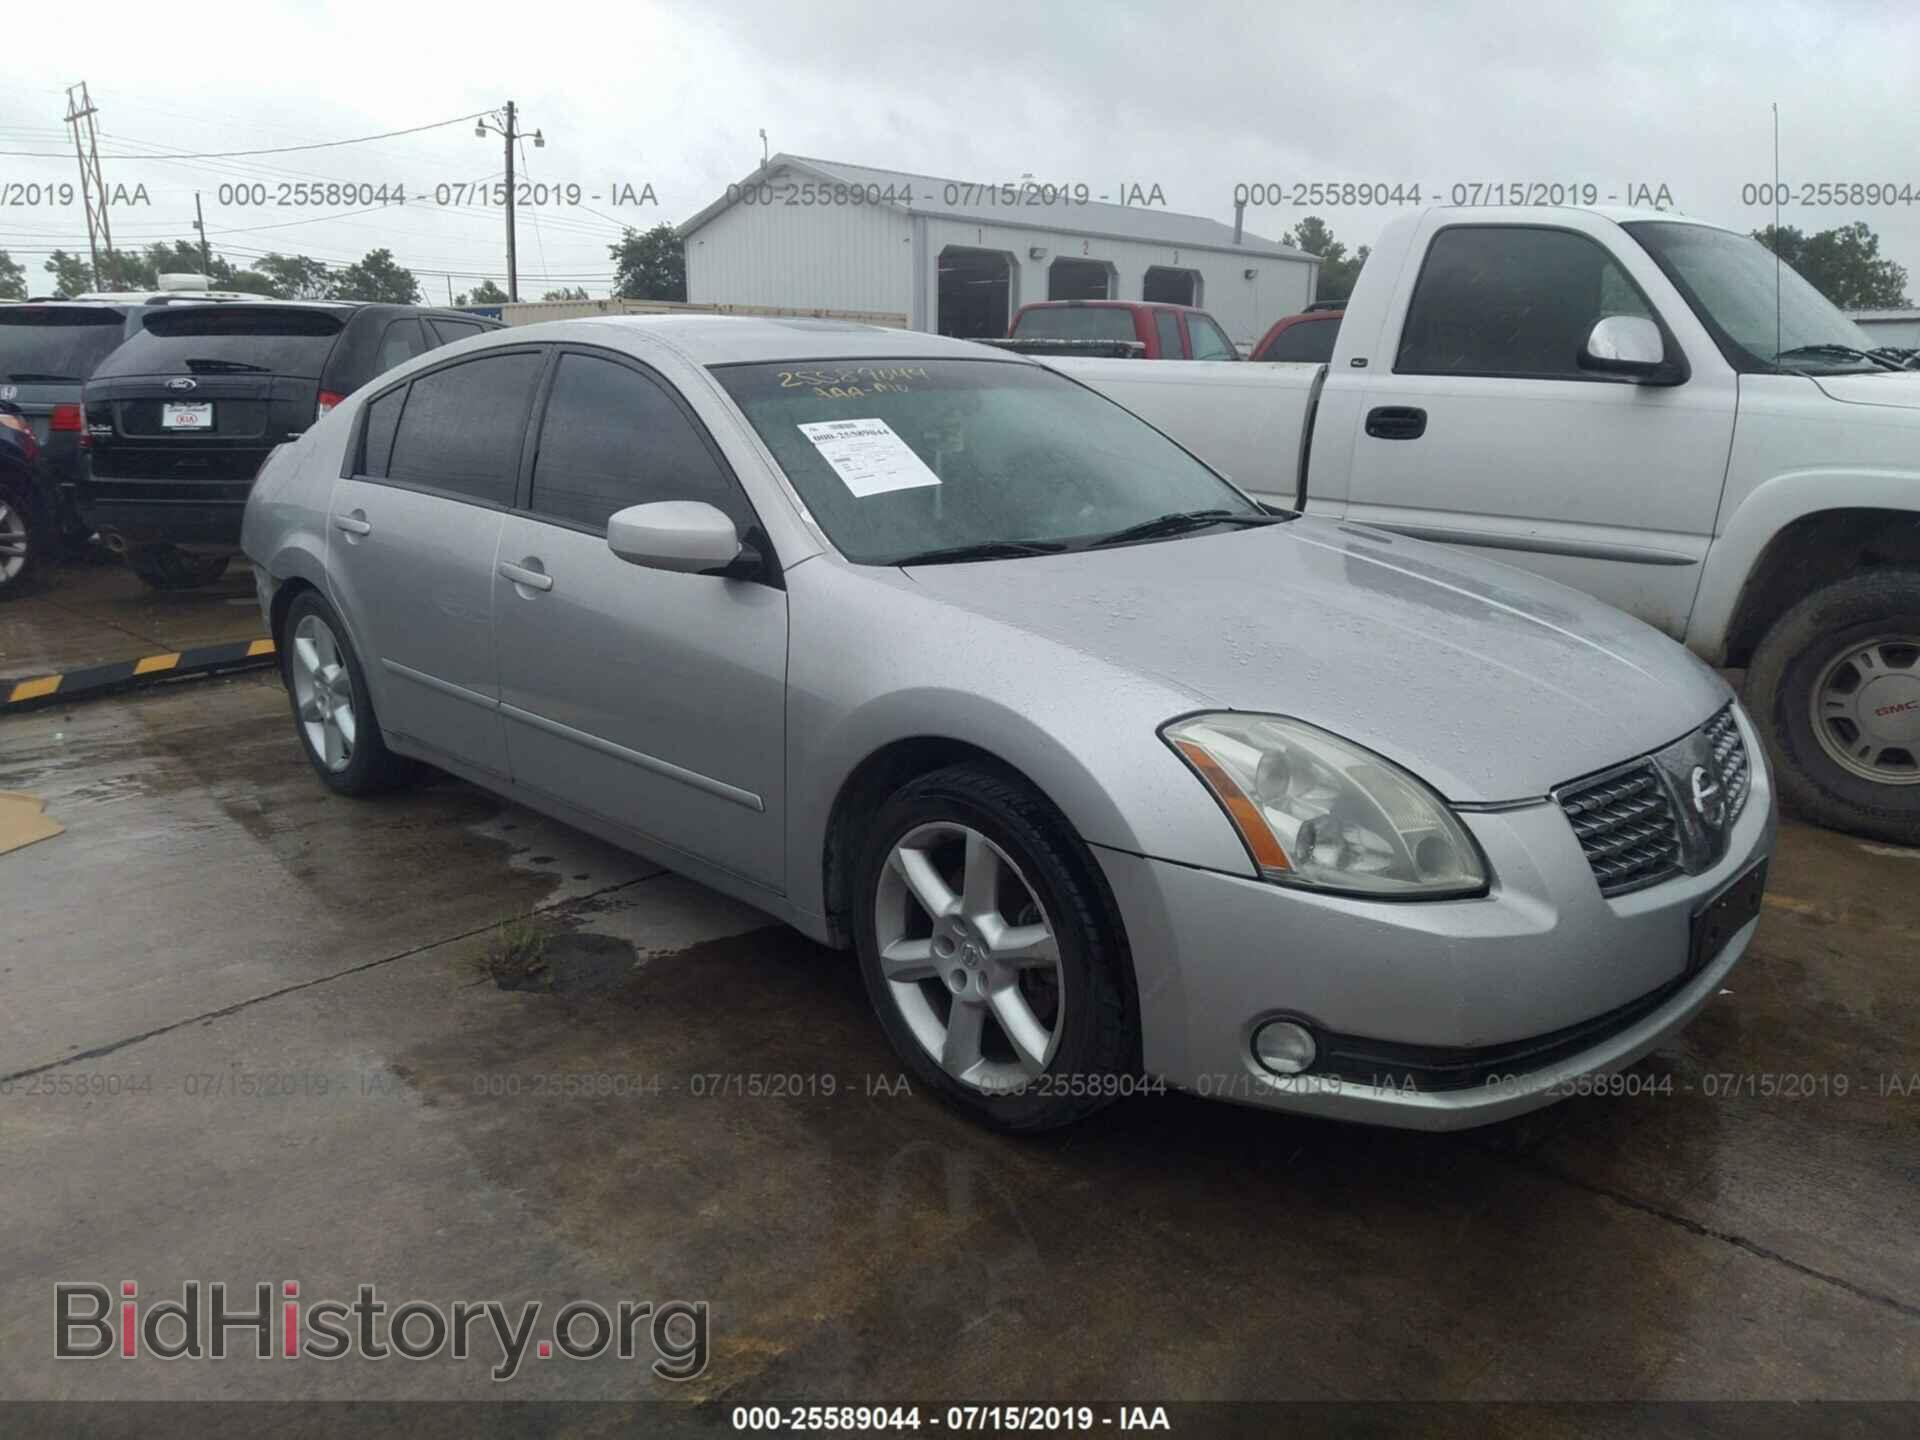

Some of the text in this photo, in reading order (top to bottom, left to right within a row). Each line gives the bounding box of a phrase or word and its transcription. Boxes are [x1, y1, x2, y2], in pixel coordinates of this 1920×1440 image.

[977, 227, 983, 245] 1
[1082, 239, 1090, 256] 2
[1875, 703, 1913, 717] GMC
